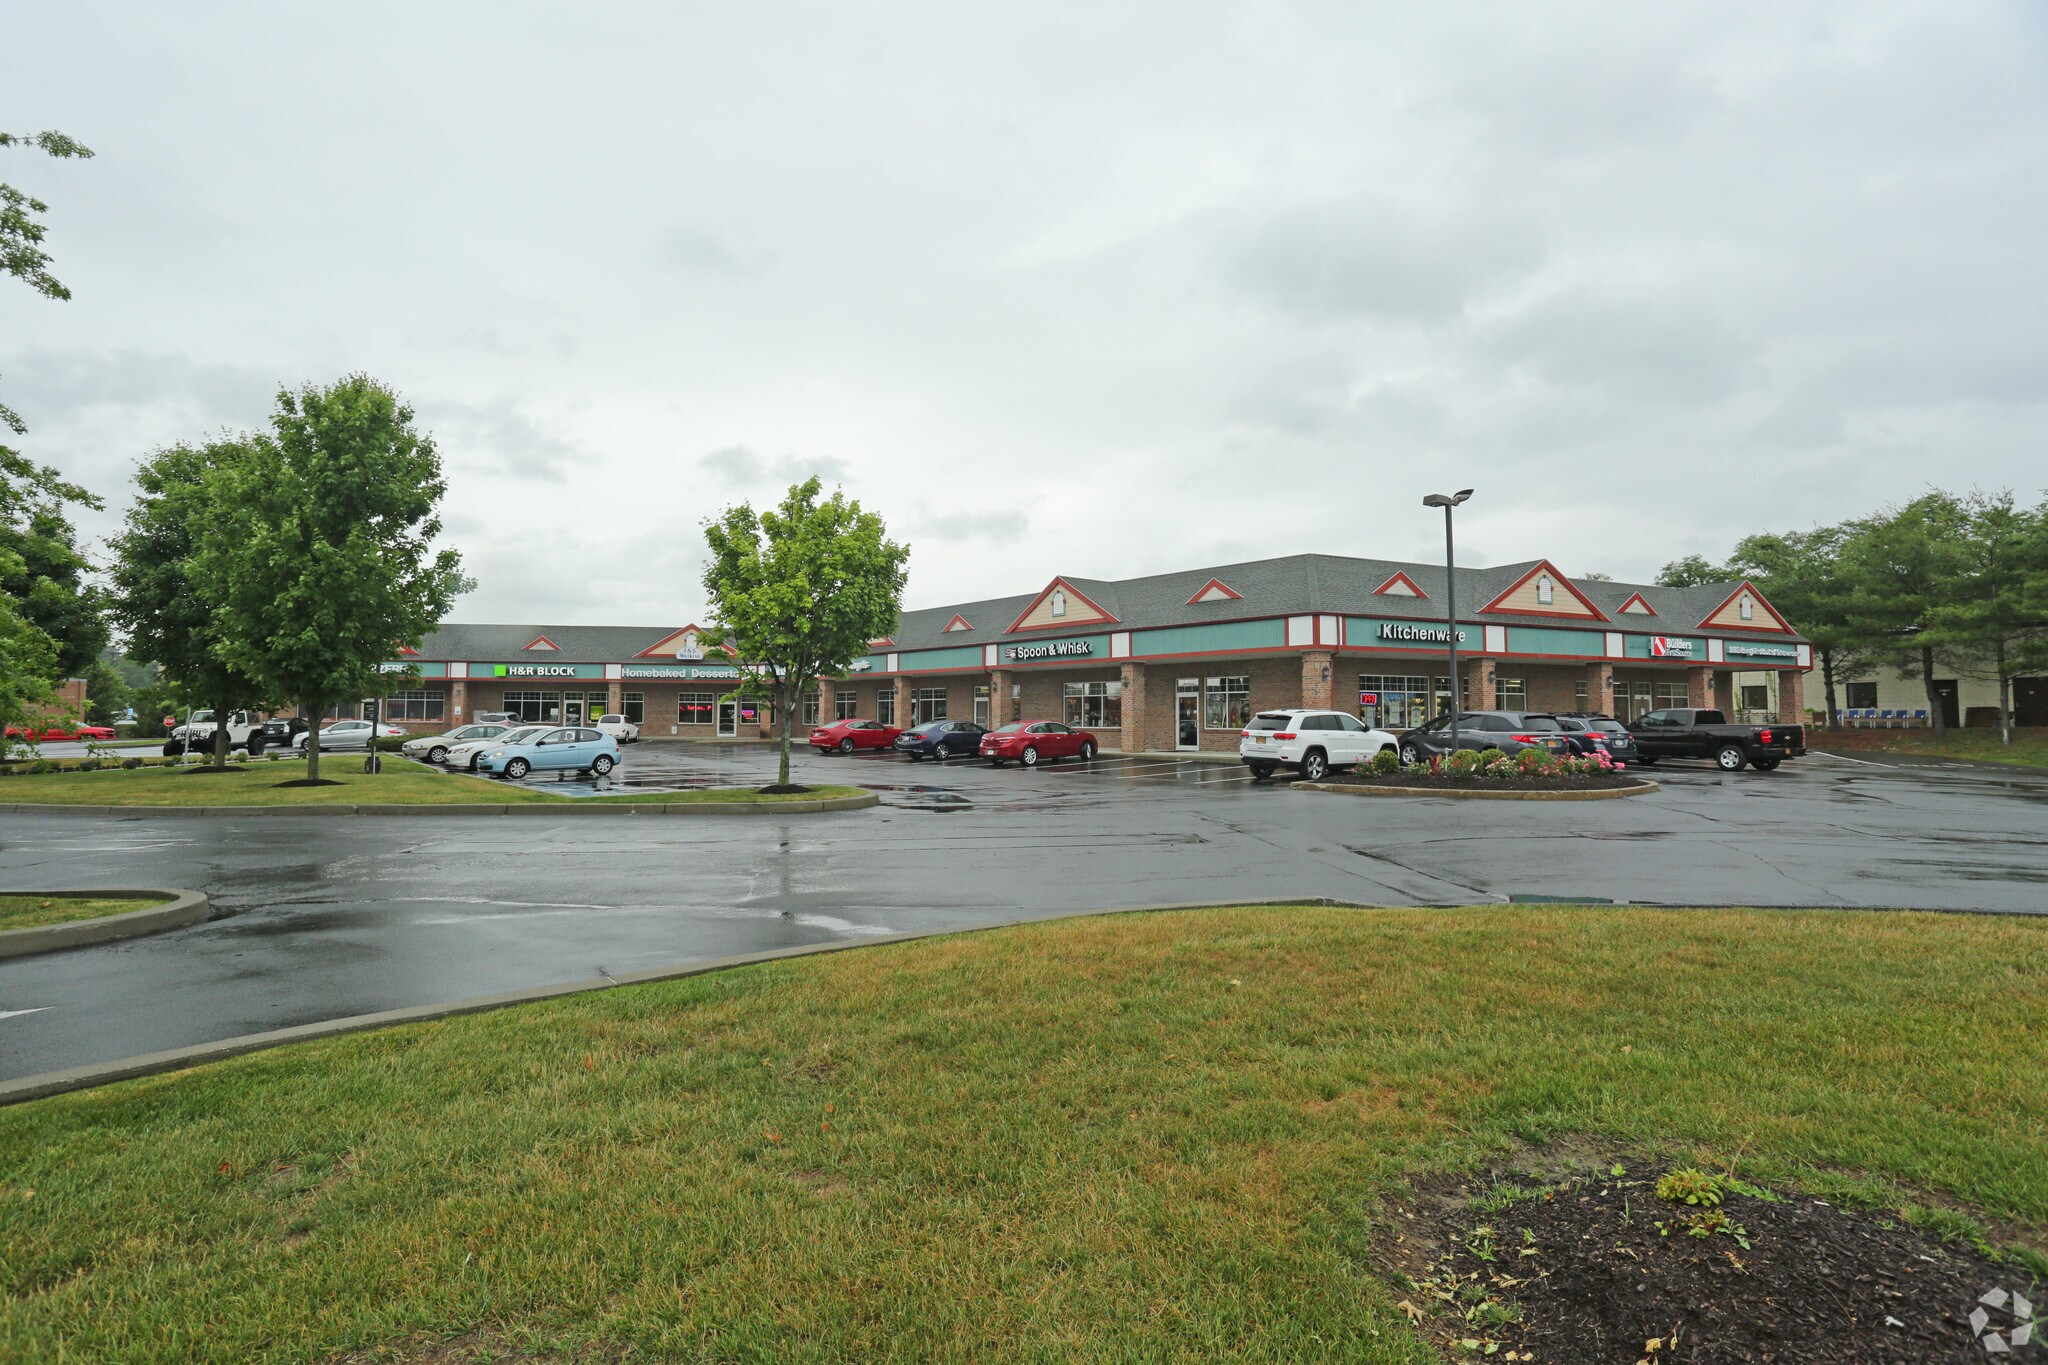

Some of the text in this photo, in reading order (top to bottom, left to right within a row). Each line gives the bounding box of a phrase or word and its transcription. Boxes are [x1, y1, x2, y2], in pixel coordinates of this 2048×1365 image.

[1383, 624, 1466, 642] Kitchenware
[1666, 638, 1692, 650] Builders
[1017, 641, 1089, 660] Spoon & Whisk
[509, 666, 575, 676] H&R BLOCK
[621, 668, 740, 678] Homebaked Desserts
